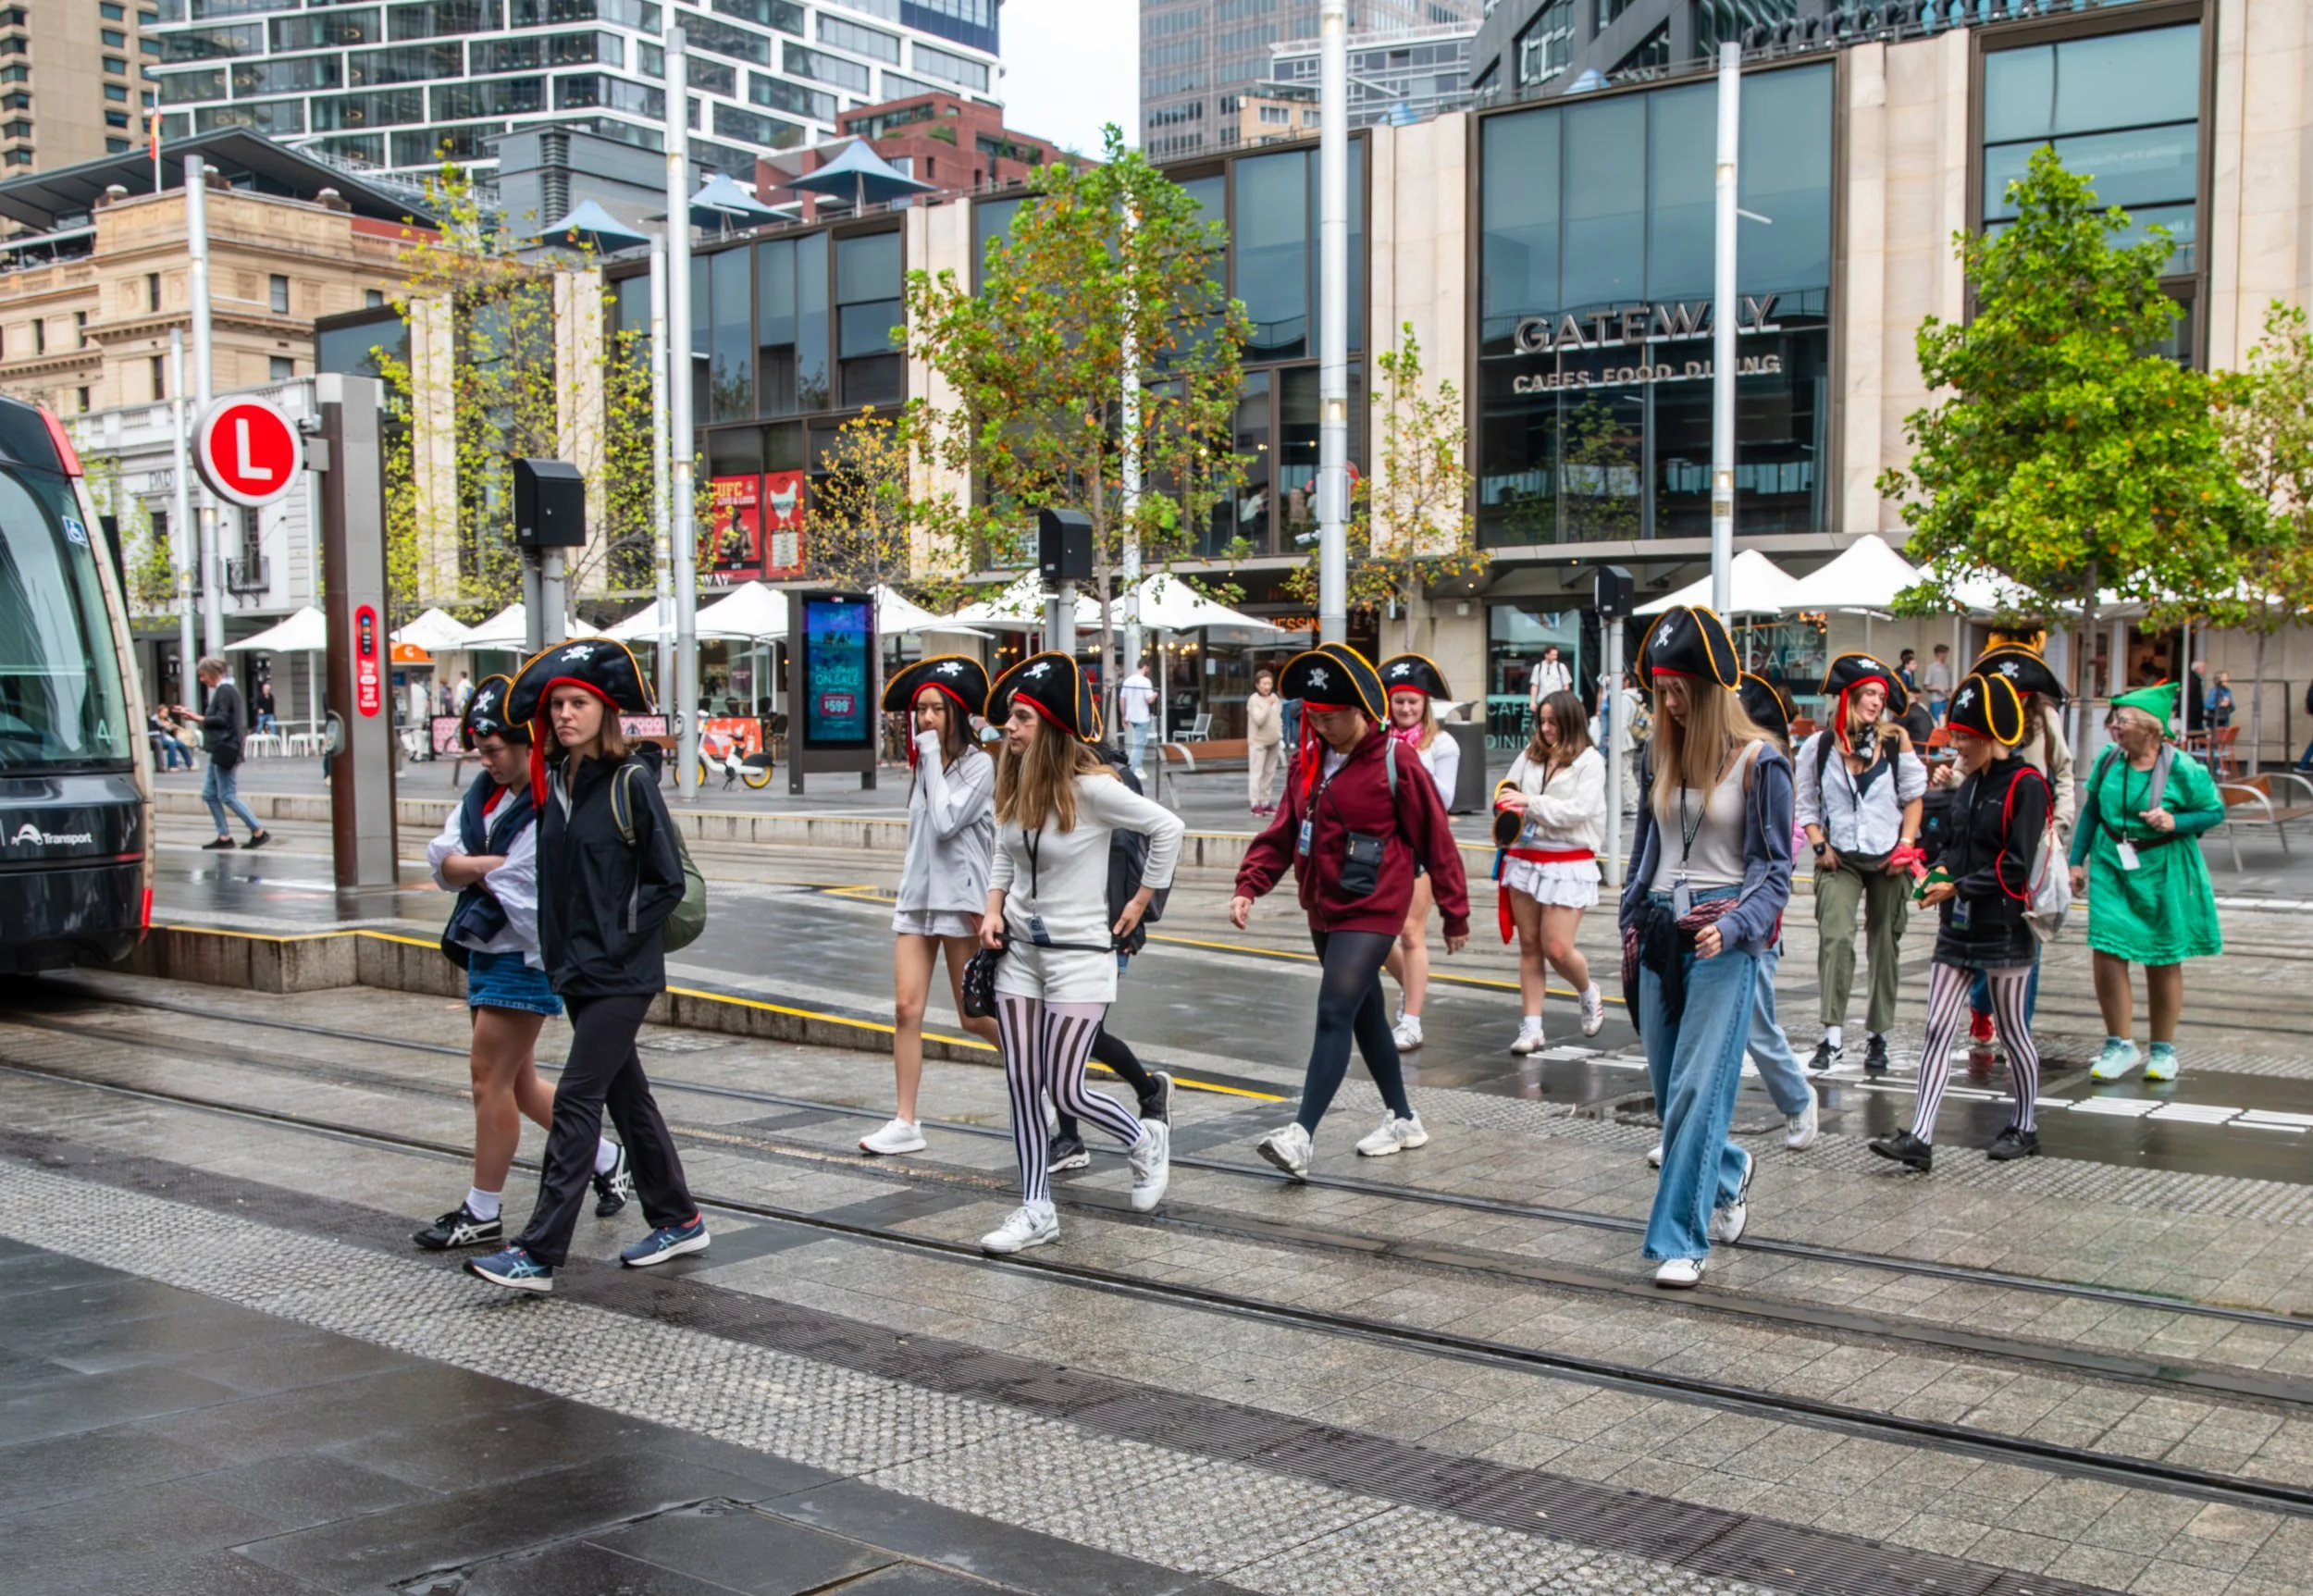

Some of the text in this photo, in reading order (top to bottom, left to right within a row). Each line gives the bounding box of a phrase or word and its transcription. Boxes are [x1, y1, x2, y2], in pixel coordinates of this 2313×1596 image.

[1514, 293, 1780, 353] GATEWY
[1513, 353, 1782, 392] CAFES FOOD DIING
[235, 417, 274, 481] L
[717, 481, 743, 497] UFC
[1731, 626, 1819, 647] DNING
[1487, 702, 1532, 716] CAFE
[1484, 734, 1530, 749] DININ
[42, 832, 93, 846] Transport
